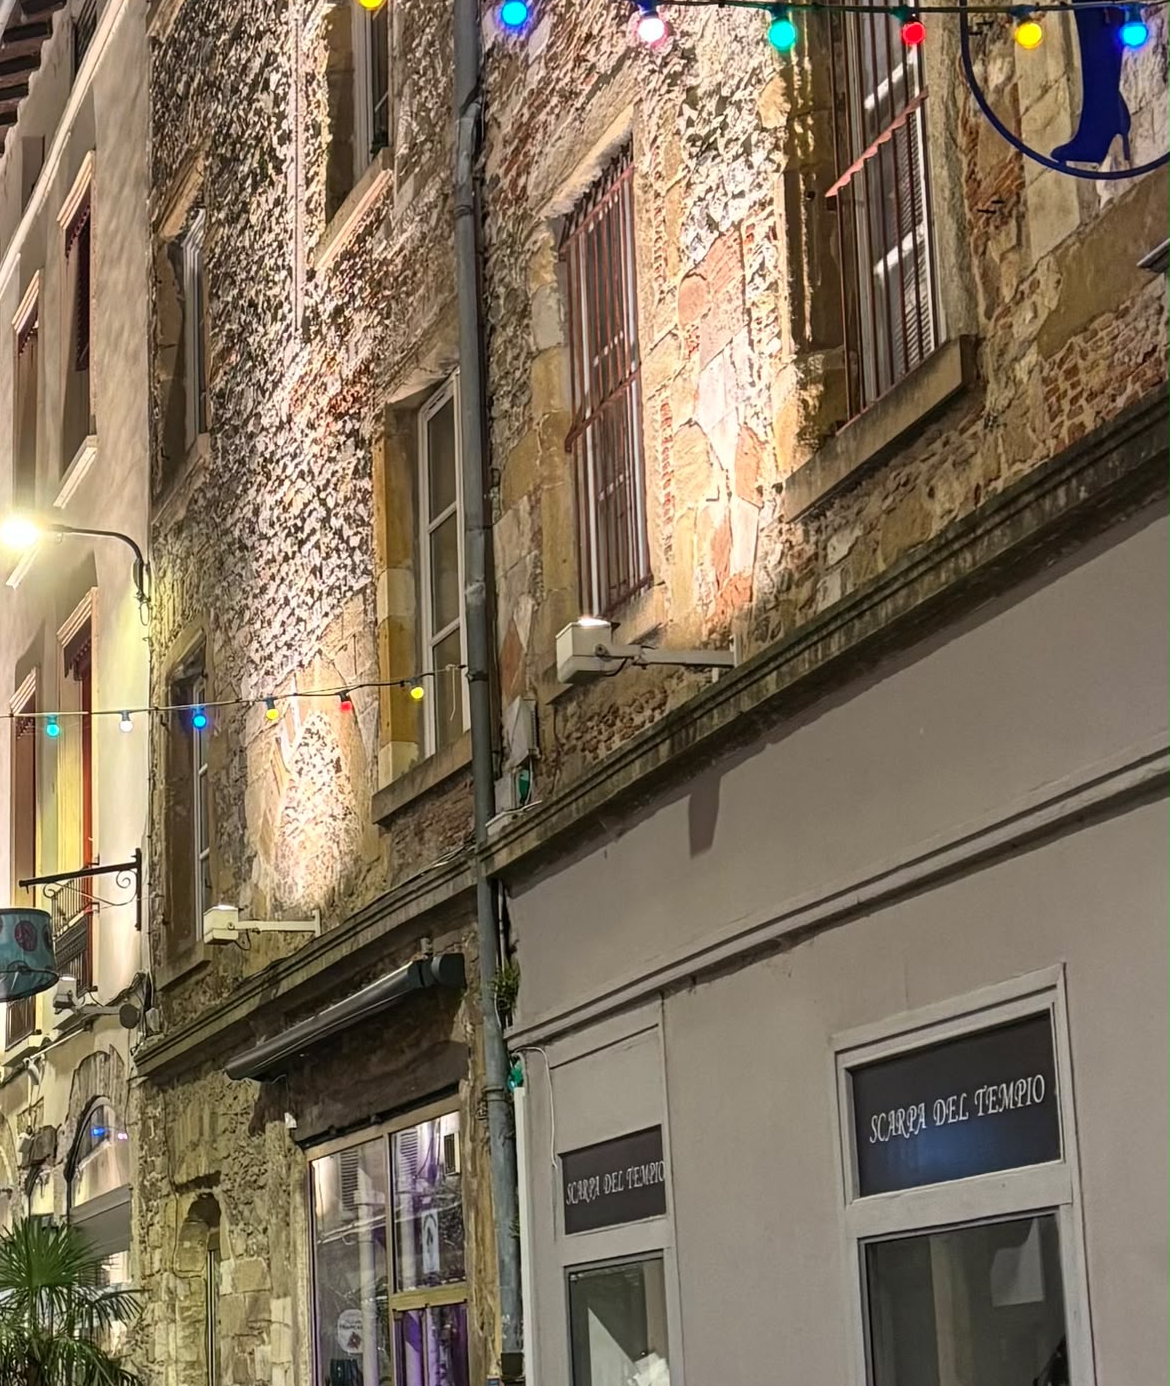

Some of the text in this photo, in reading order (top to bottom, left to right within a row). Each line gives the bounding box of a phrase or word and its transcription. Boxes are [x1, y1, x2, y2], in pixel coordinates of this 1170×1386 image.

[869, 1074, 1045, 1144] SCARPA DEL TEMPIO
[566, 1160, 665, 1205] SCARPA DEL TEMPIO
